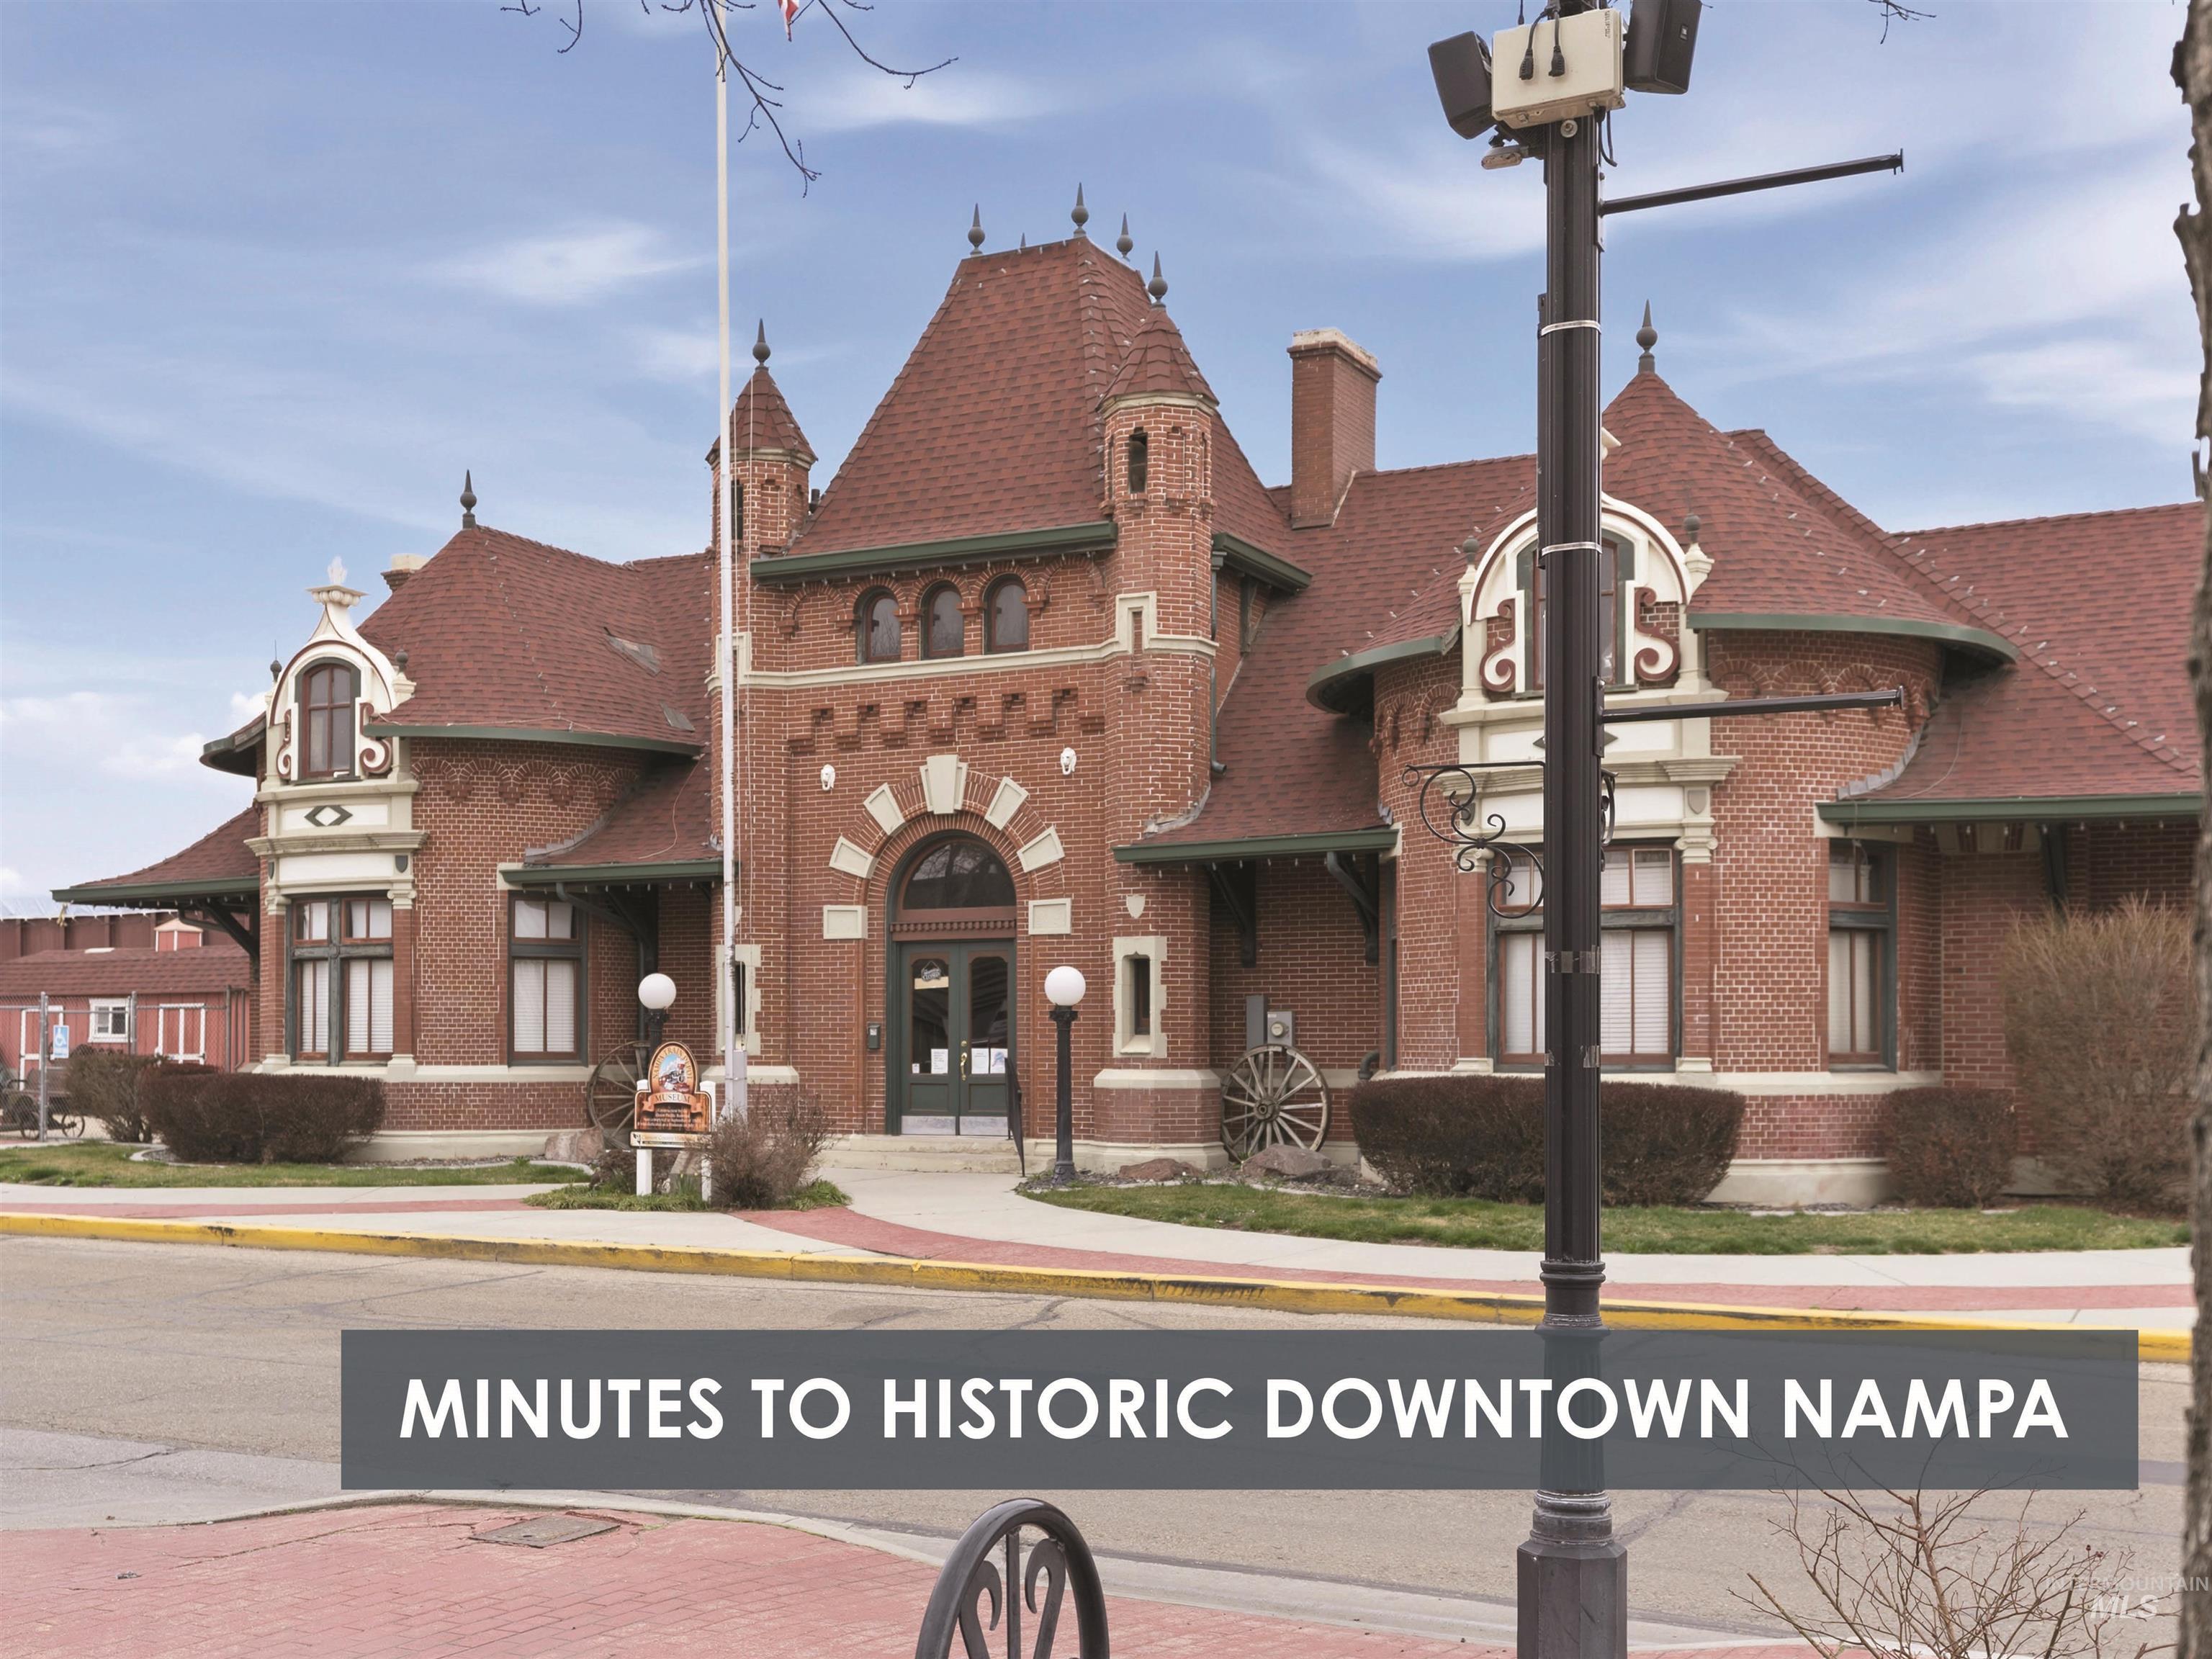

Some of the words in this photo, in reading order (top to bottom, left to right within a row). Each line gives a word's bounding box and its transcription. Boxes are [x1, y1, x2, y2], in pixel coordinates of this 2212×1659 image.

[653, 1053, 665, 1079] NAMPA
[663, 1047, 683, 1057] TRAIN
[682, 1054, 693, 1079] DEPOT
[655, 1093, 691, 1102] MUSEUM
